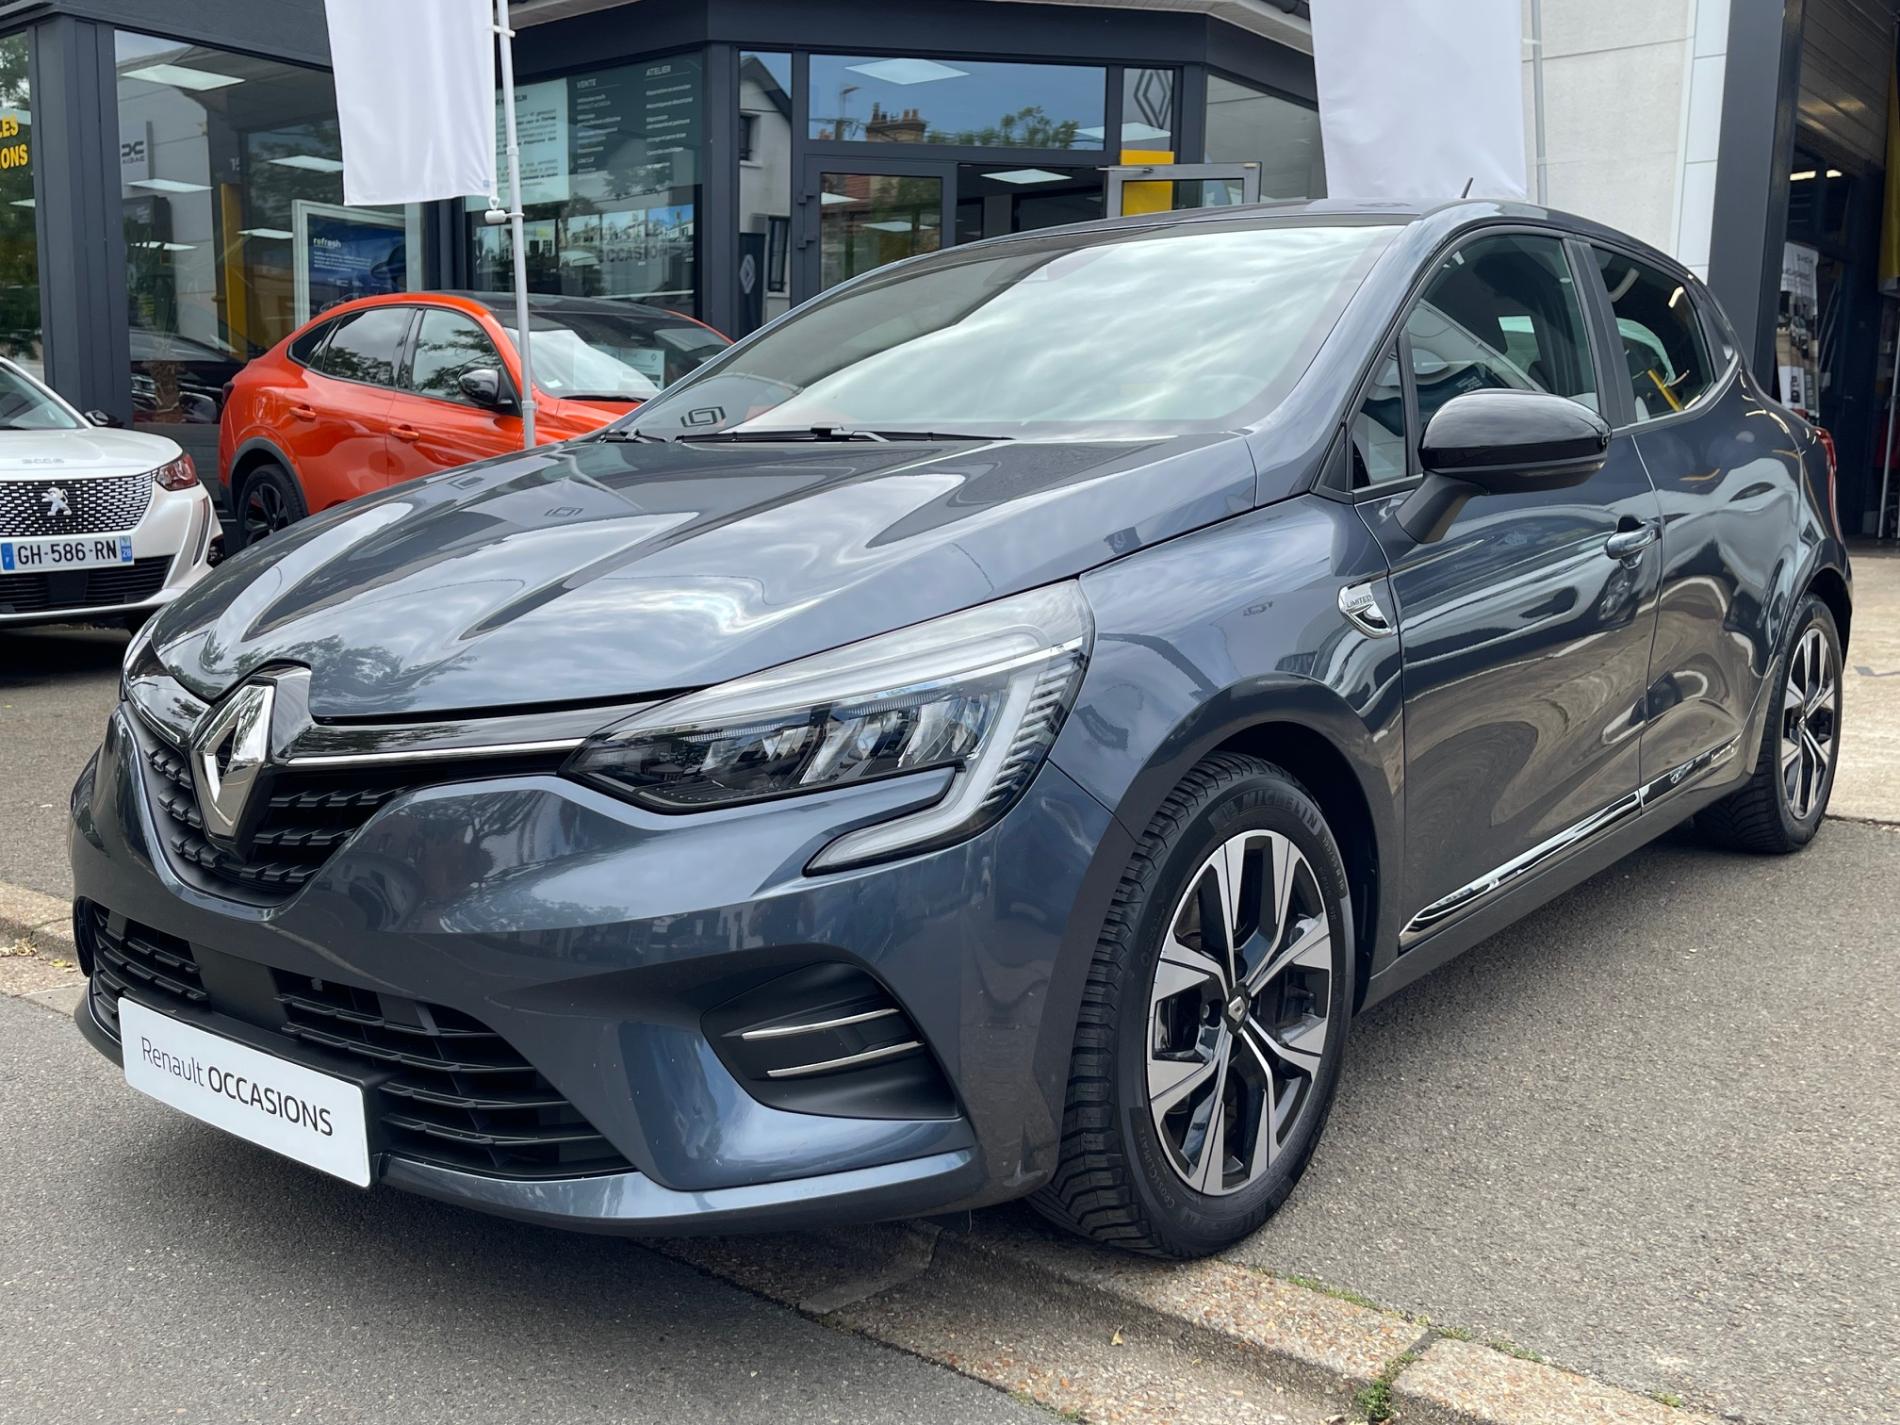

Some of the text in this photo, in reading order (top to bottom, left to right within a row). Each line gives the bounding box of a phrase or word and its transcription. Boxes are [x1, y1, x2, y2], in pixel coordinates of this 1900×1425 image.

[0, 143, 28, 170] ONS
[17, 540, 118, 565] GH-586-RN
[141, 1036, 333, 1137] Renault OCCASIONS
